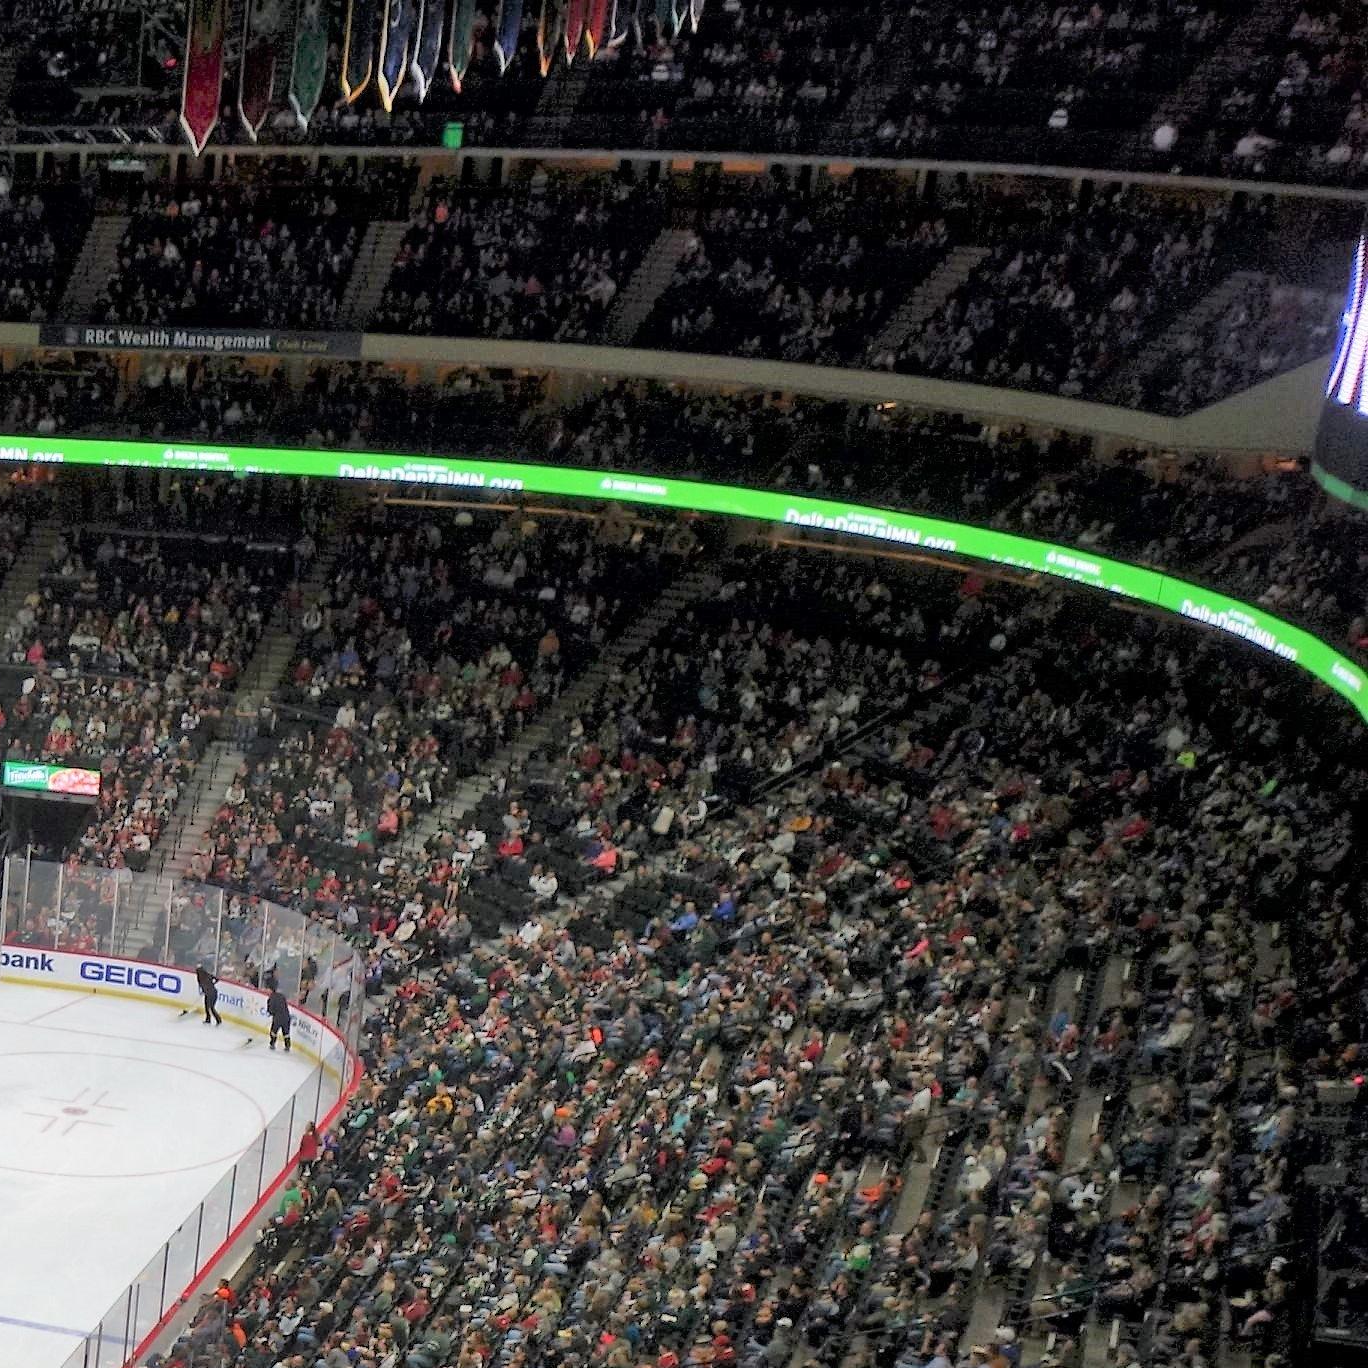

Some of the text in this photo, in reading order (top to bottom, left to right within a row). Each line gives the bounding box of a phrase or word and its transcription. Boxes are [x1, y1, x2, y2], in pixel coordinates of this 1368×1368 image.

[85, 328, 114, 345] RBC
[119, 330, 169, 347] Wealth
[174, 331, 271, 351] Management
[338, 463, 523, 490] DeltaDentalMNorg
[784, 508, 956, 552] DeltaDentalMNorg
[80, 960, 182, 994] GEICO
